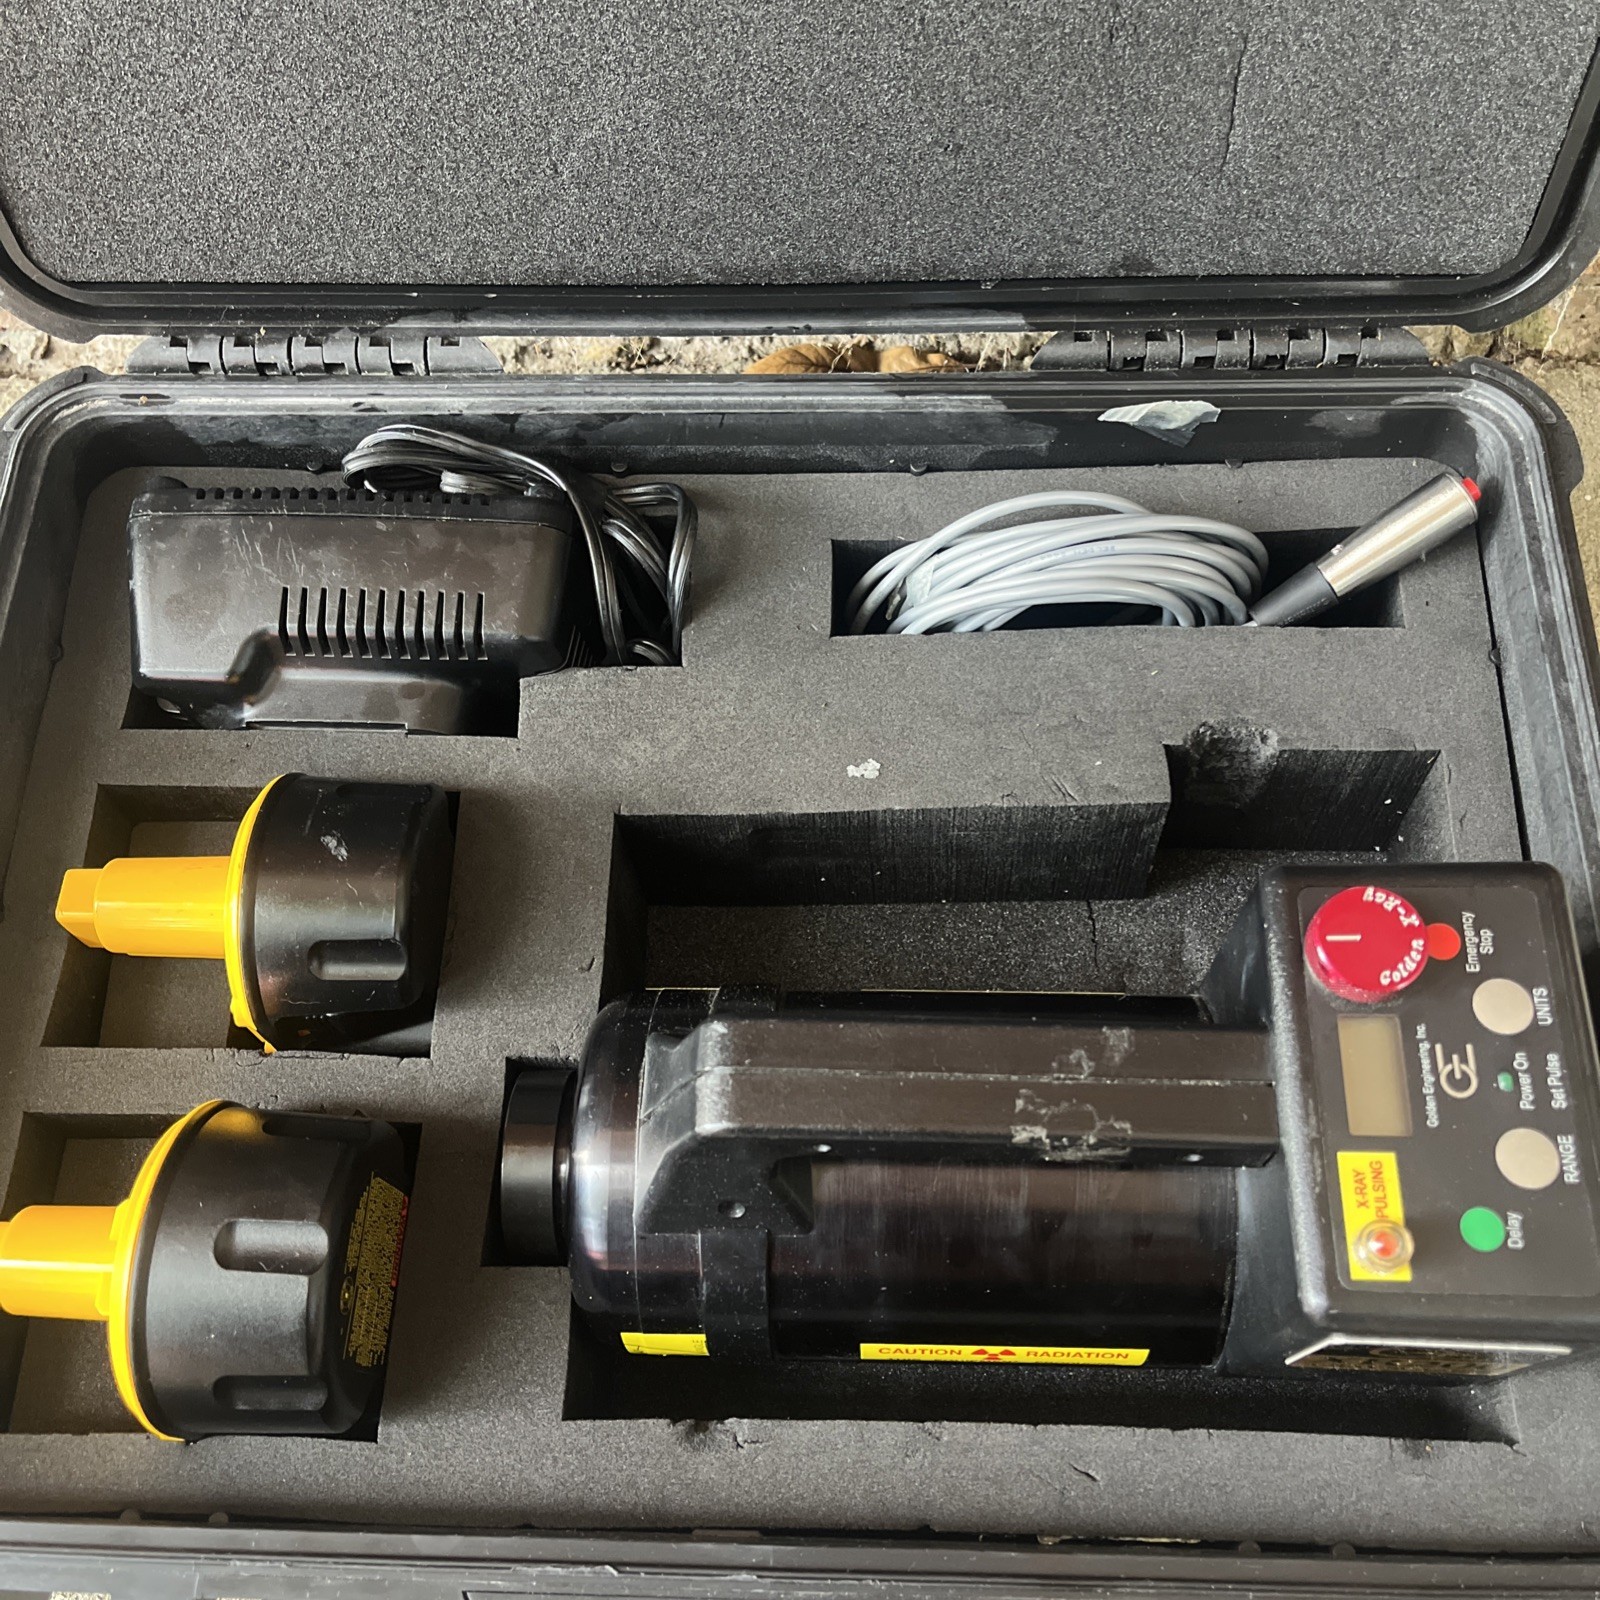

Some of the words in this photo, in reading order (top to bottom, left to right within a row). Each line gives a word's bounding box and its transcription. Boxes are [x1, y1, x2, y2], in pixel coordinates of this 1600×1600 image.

[1362, 885, 1420, 928] X-Ray
[1463, 911, 1480, 974] Emergency
[1479, 928, 1494, 956] Stop
[1379, 937, 1425, 987] Golden
[1533, 987, 1552, 1026] UNITS
[1415, 1023, 1427, 1040] Inc.
[1418, 1041, 1436, 1095] Engineering,
[1512, 1052, 1530, 1071] On
[1547, 1053, 1564, 1087] Pulse
[1519, 1072, 1535, 1111] Power
[1551, 1088, 1567, 1110] Set
[1425, 1095, 1440, 1128] Golden
[1557, 1134, 1580, 1185] RANGE
[1353, 1169, 1370, 1209] X-RAY
[1371, 1160, 1389, 1220] PULSING
[1507, 1211, 1524, 1250] Delay
[877, 1346, 963, 1357] CAUTION
[1025, 1349, 1130, 1361] RADIATION
